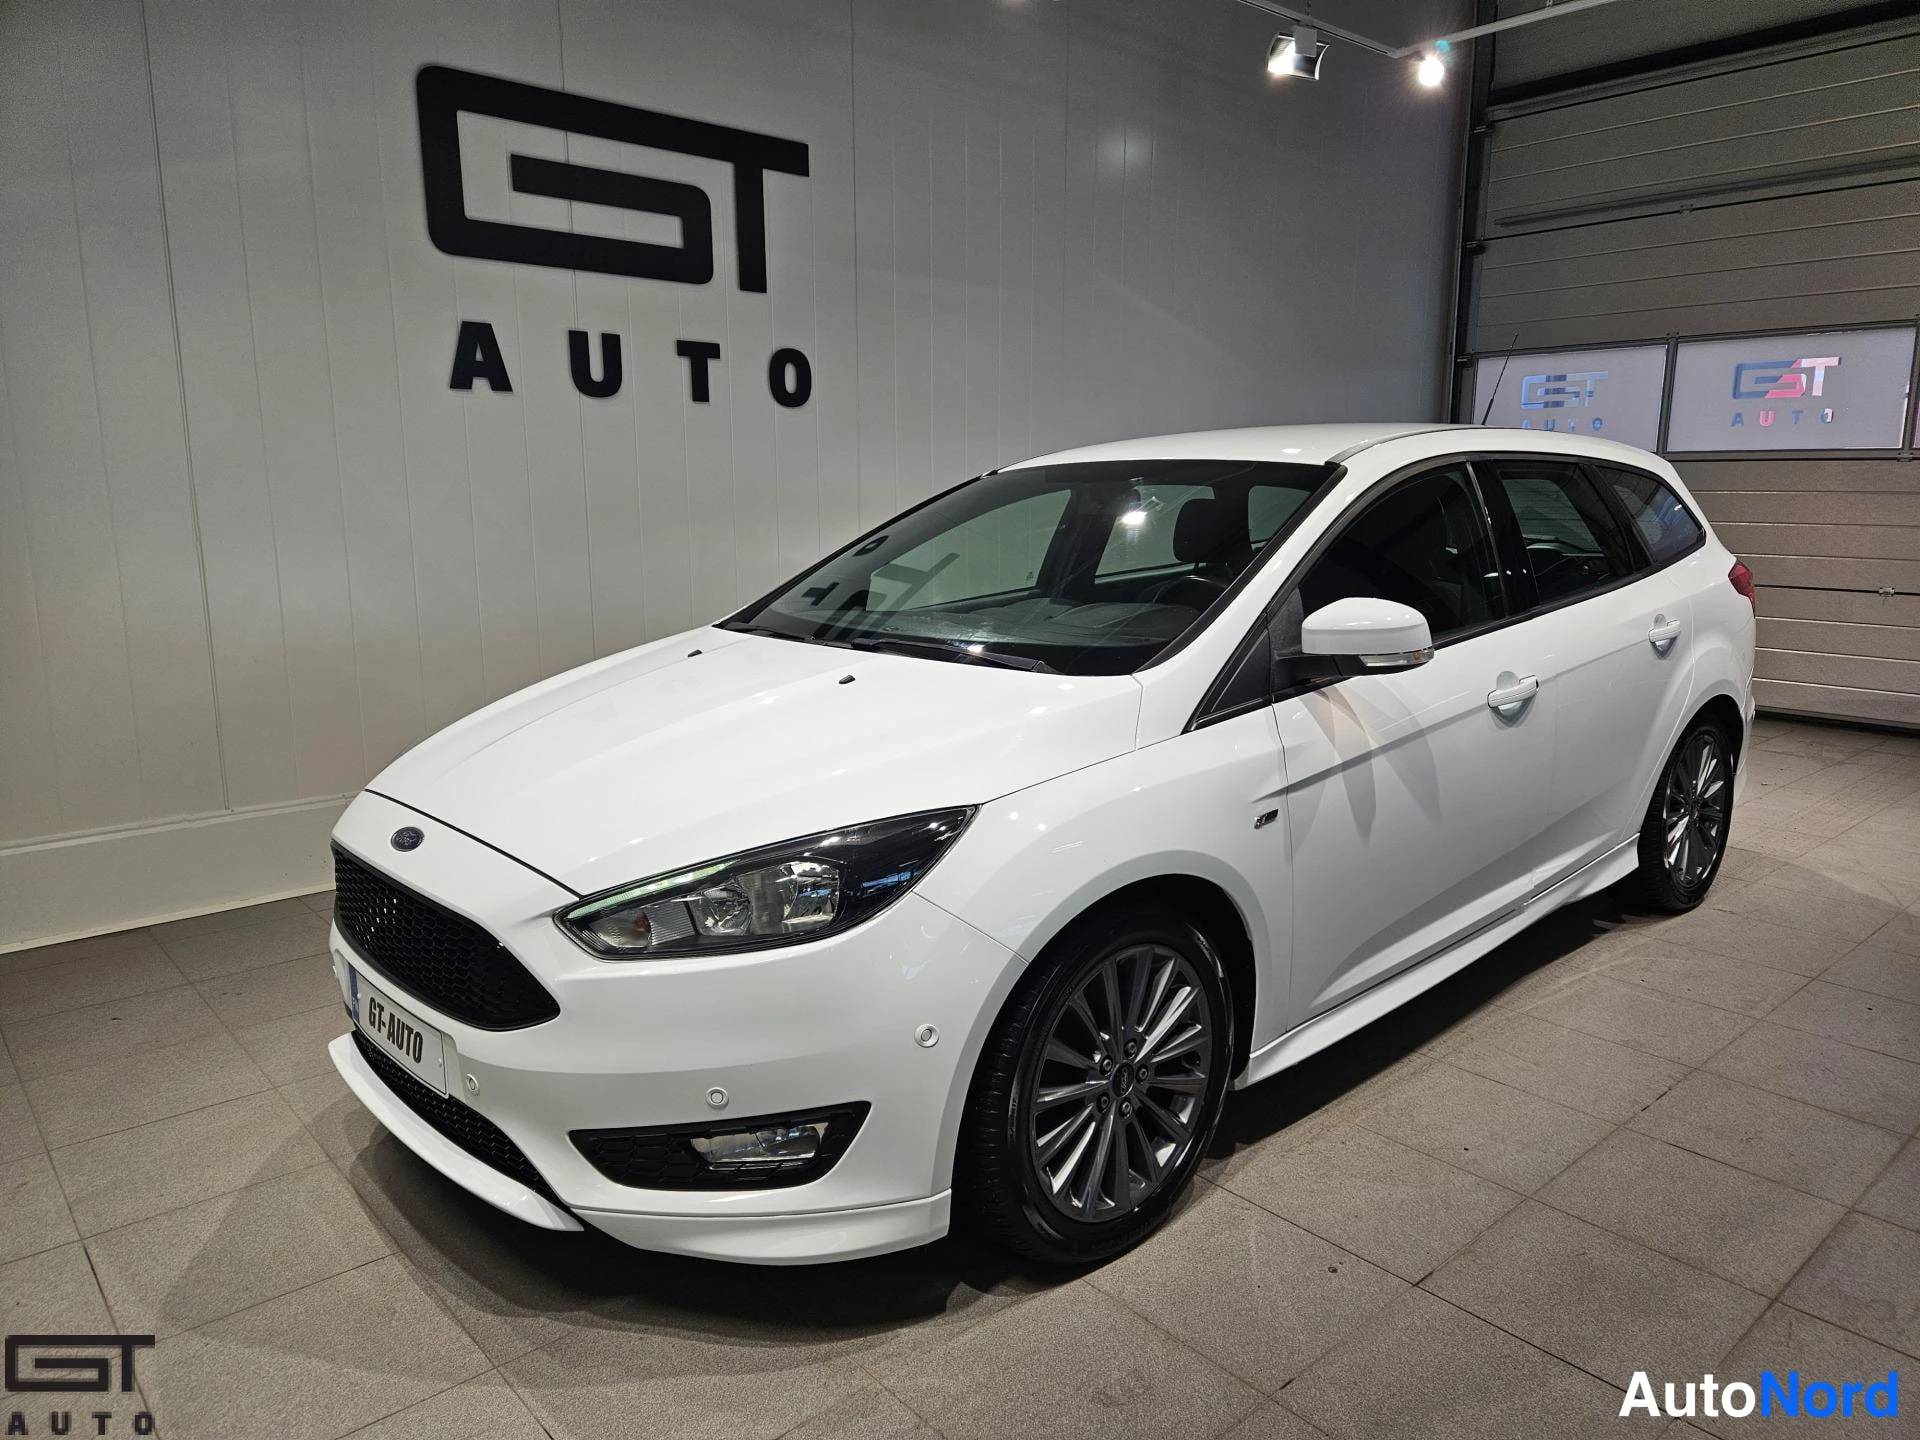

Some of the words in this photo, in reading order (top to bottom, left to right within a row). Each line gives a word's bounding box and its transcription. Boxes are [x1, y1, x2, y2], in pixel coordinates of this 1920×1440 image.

[450, 321, 812, 408] AUTO
[1731, 408, 1834, 427] AUTO
[368, 997, 423, 1063] GT-AUTO
